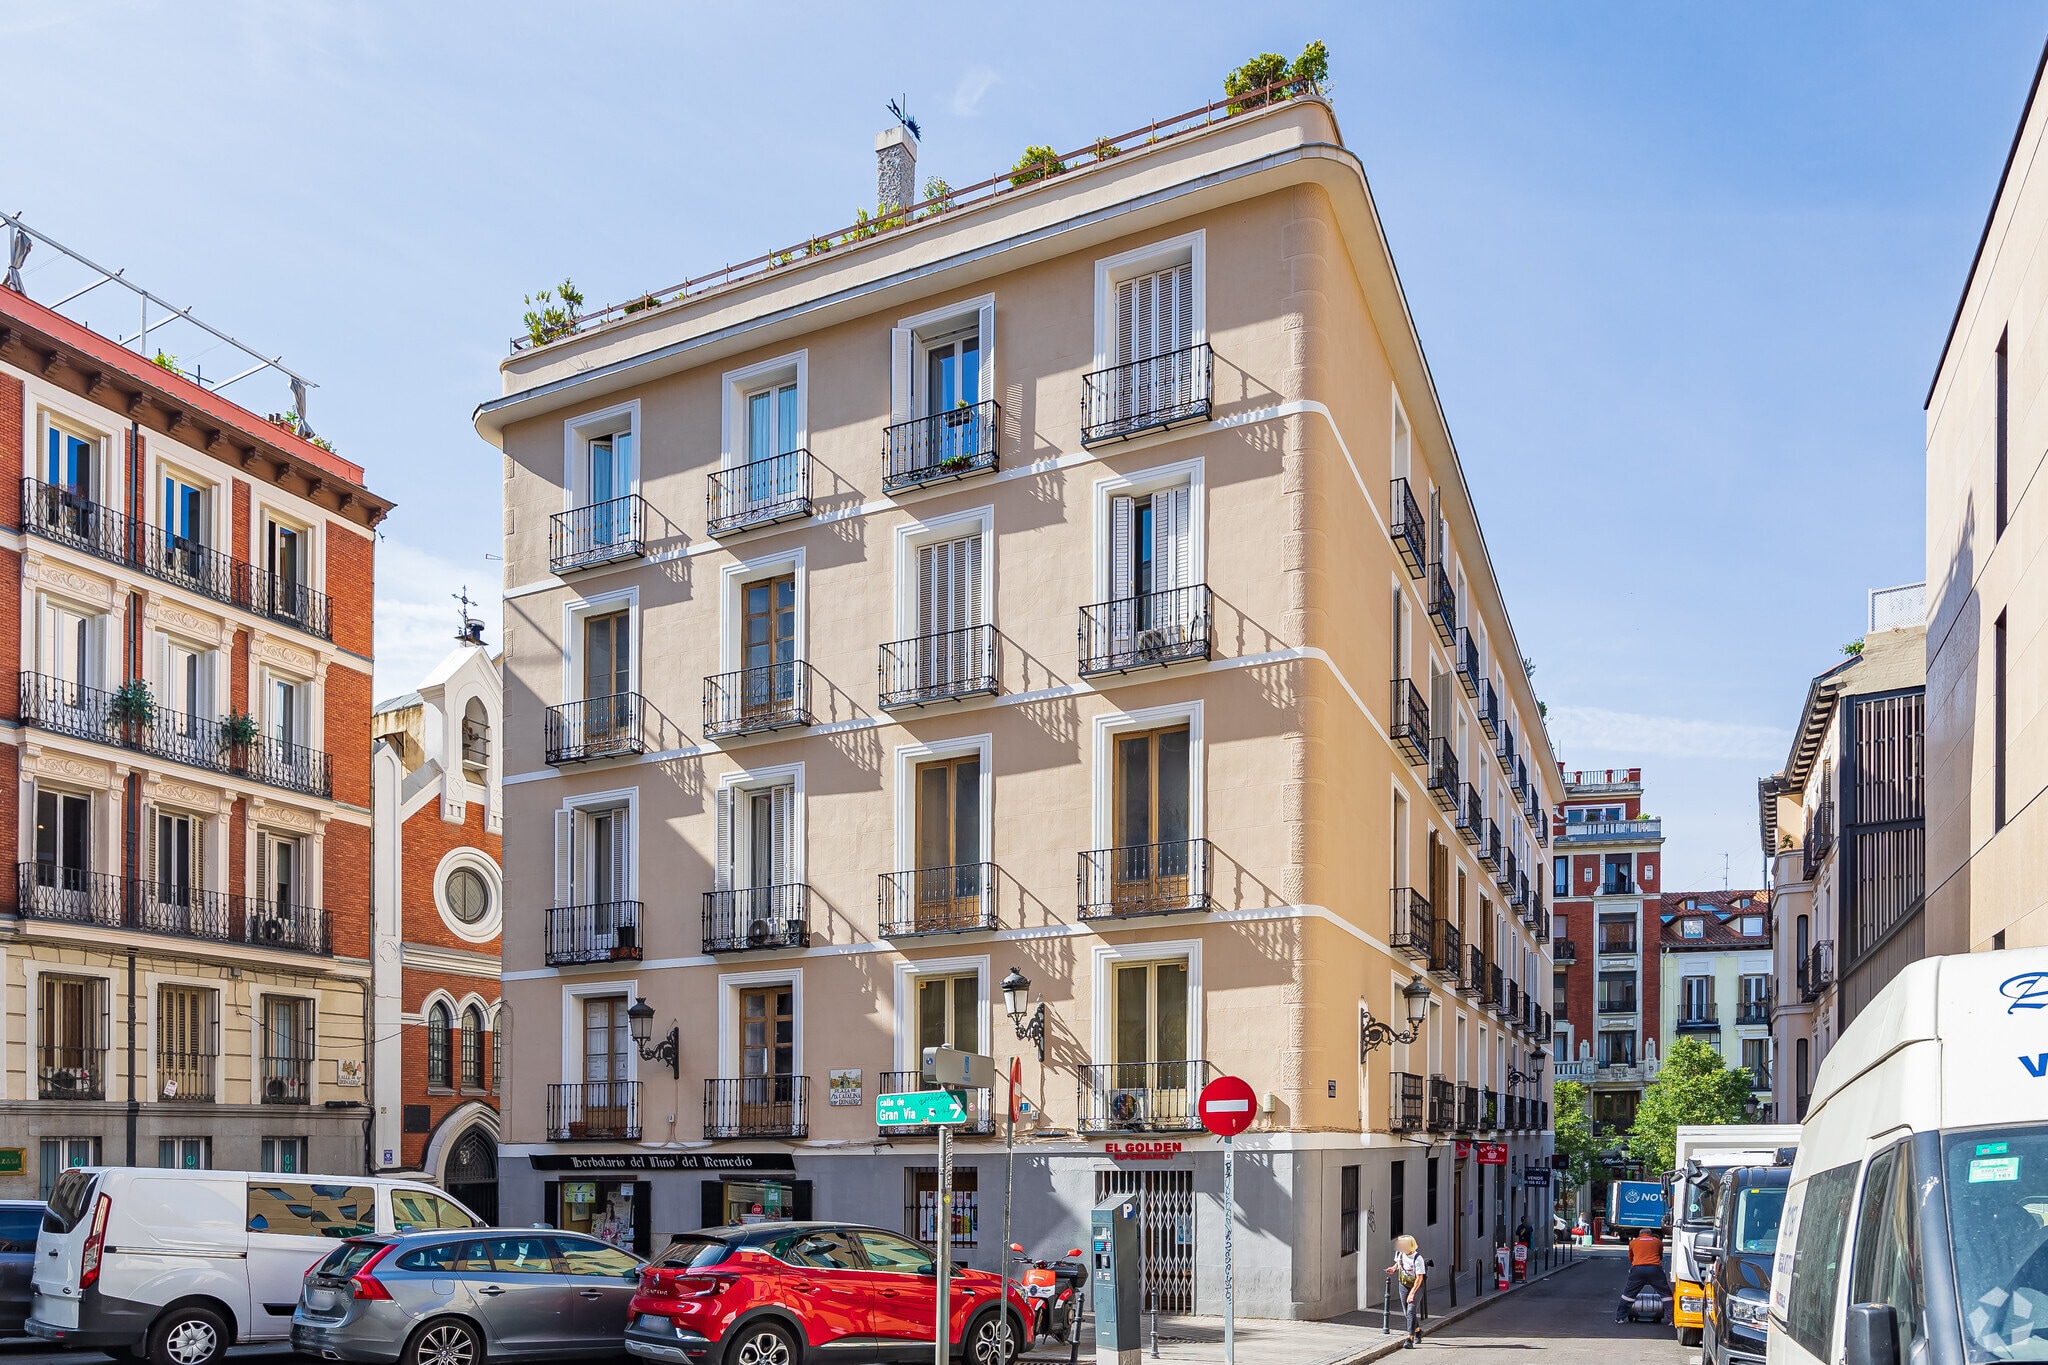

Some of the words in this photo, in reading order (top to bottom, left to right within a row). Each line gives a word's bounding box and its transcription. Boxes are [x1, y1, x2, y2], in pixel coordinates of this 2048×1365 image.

[880, 1098, 894, 1107] calle
[897, 1097, 904, 1106] de
[880, 1109, 898, 1121] Gran
[903, 1107, 916, 1120] Vía
[1105, 1143, 1122, 1153] EL
[1125, 1142, 1182, 1153] GOLDEN
[570, 1156, 626, 1168] Herbolario
[630, 1157, 646, 1168] del
[682, 1156, 699, 1168] del
[702, 1155, 753, 1168] Remedio
[1114, 1153, 1175, 1161] SUPERMARKET
[1123, 1203, 1133, 1219] P
